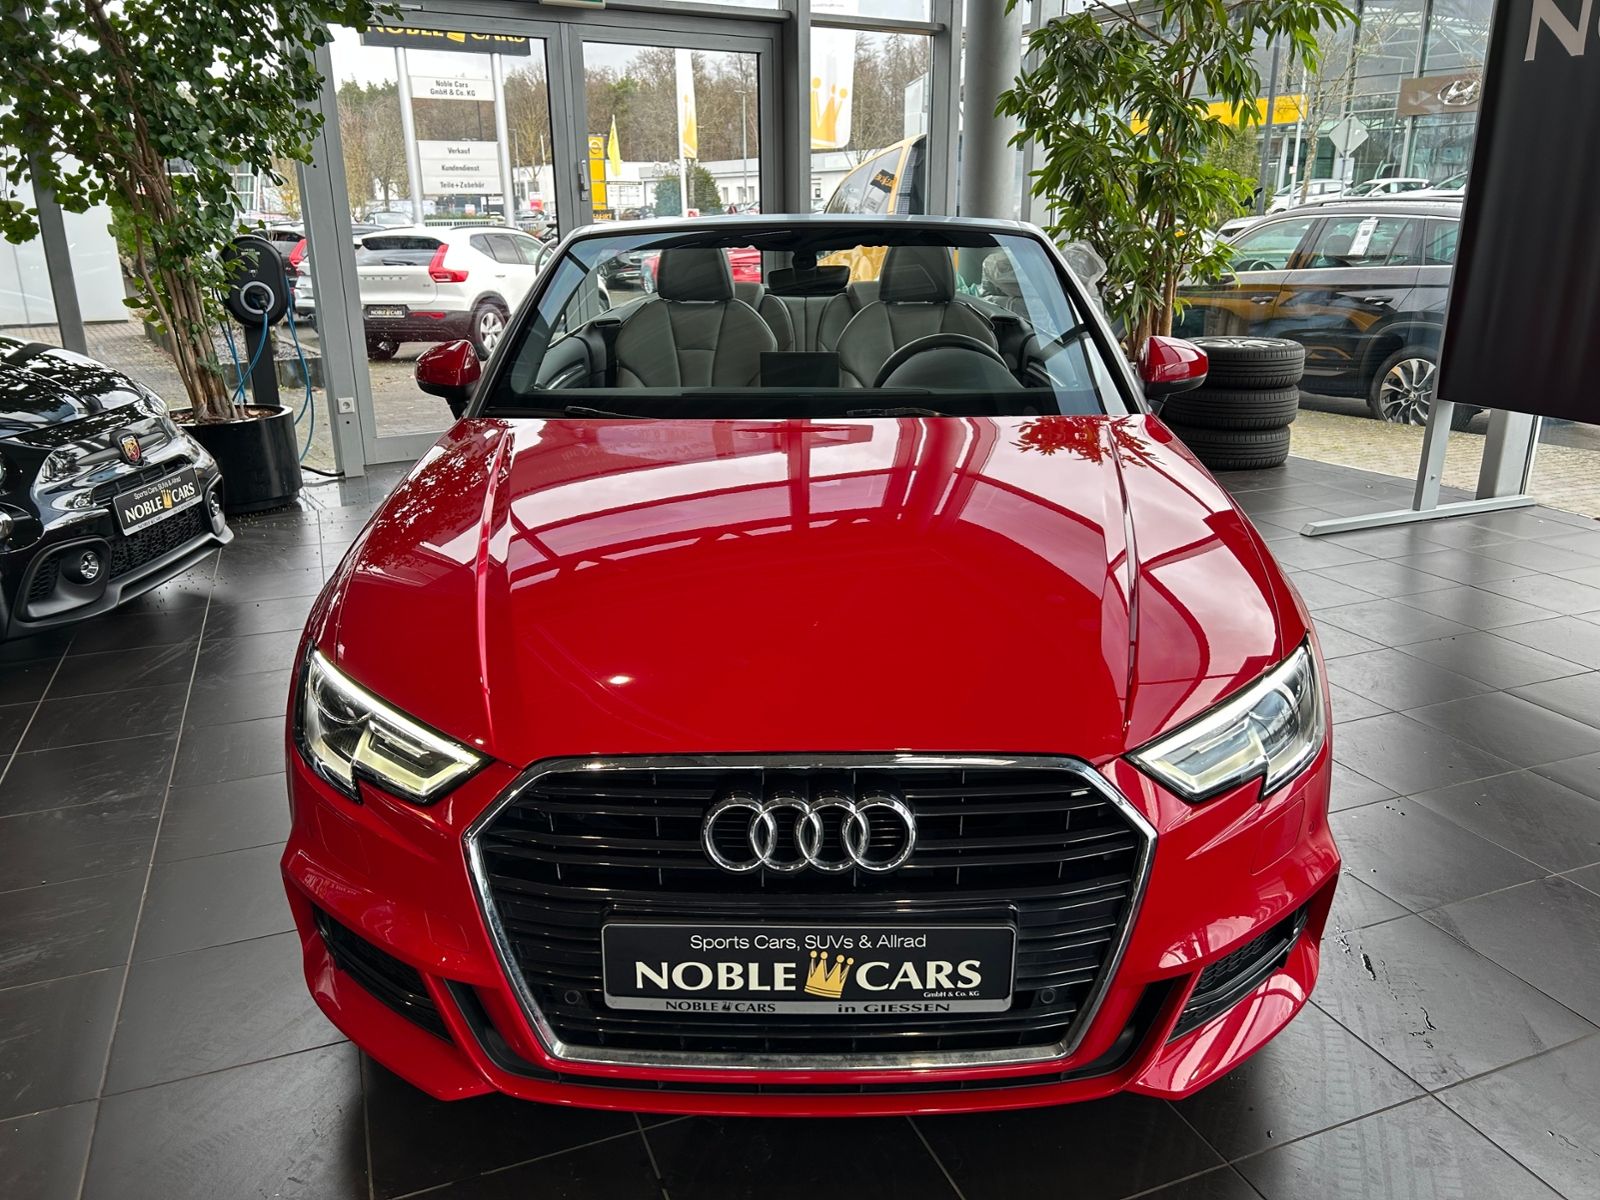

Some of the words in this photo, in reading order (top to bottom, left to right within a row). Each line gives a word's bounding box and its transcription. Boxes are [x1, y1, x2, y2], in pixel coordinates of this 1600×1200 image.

[1524, 0, 1600, 61] N
[124, 496, 164, 523] NOBLE
[171, 482, 196, 503] CARS
[690, 934, 750, 951] Sports
[754, 934, 801, 951] Cars,
[804, 934, 854, 949] SUVs
[858, 934, 873, 949] &
[876, 934, 927, 948] Allrad
[635, 961, 797, 991] NOBLE
[855, 960, 982, 991] CARS
[665, 1001, 719, 1011] NOBLE
[734, 1002, 776, 1013] CARS
[837, 1003, 856, 1013] in
[863, 1003, 951, 1013] GIESSEN
